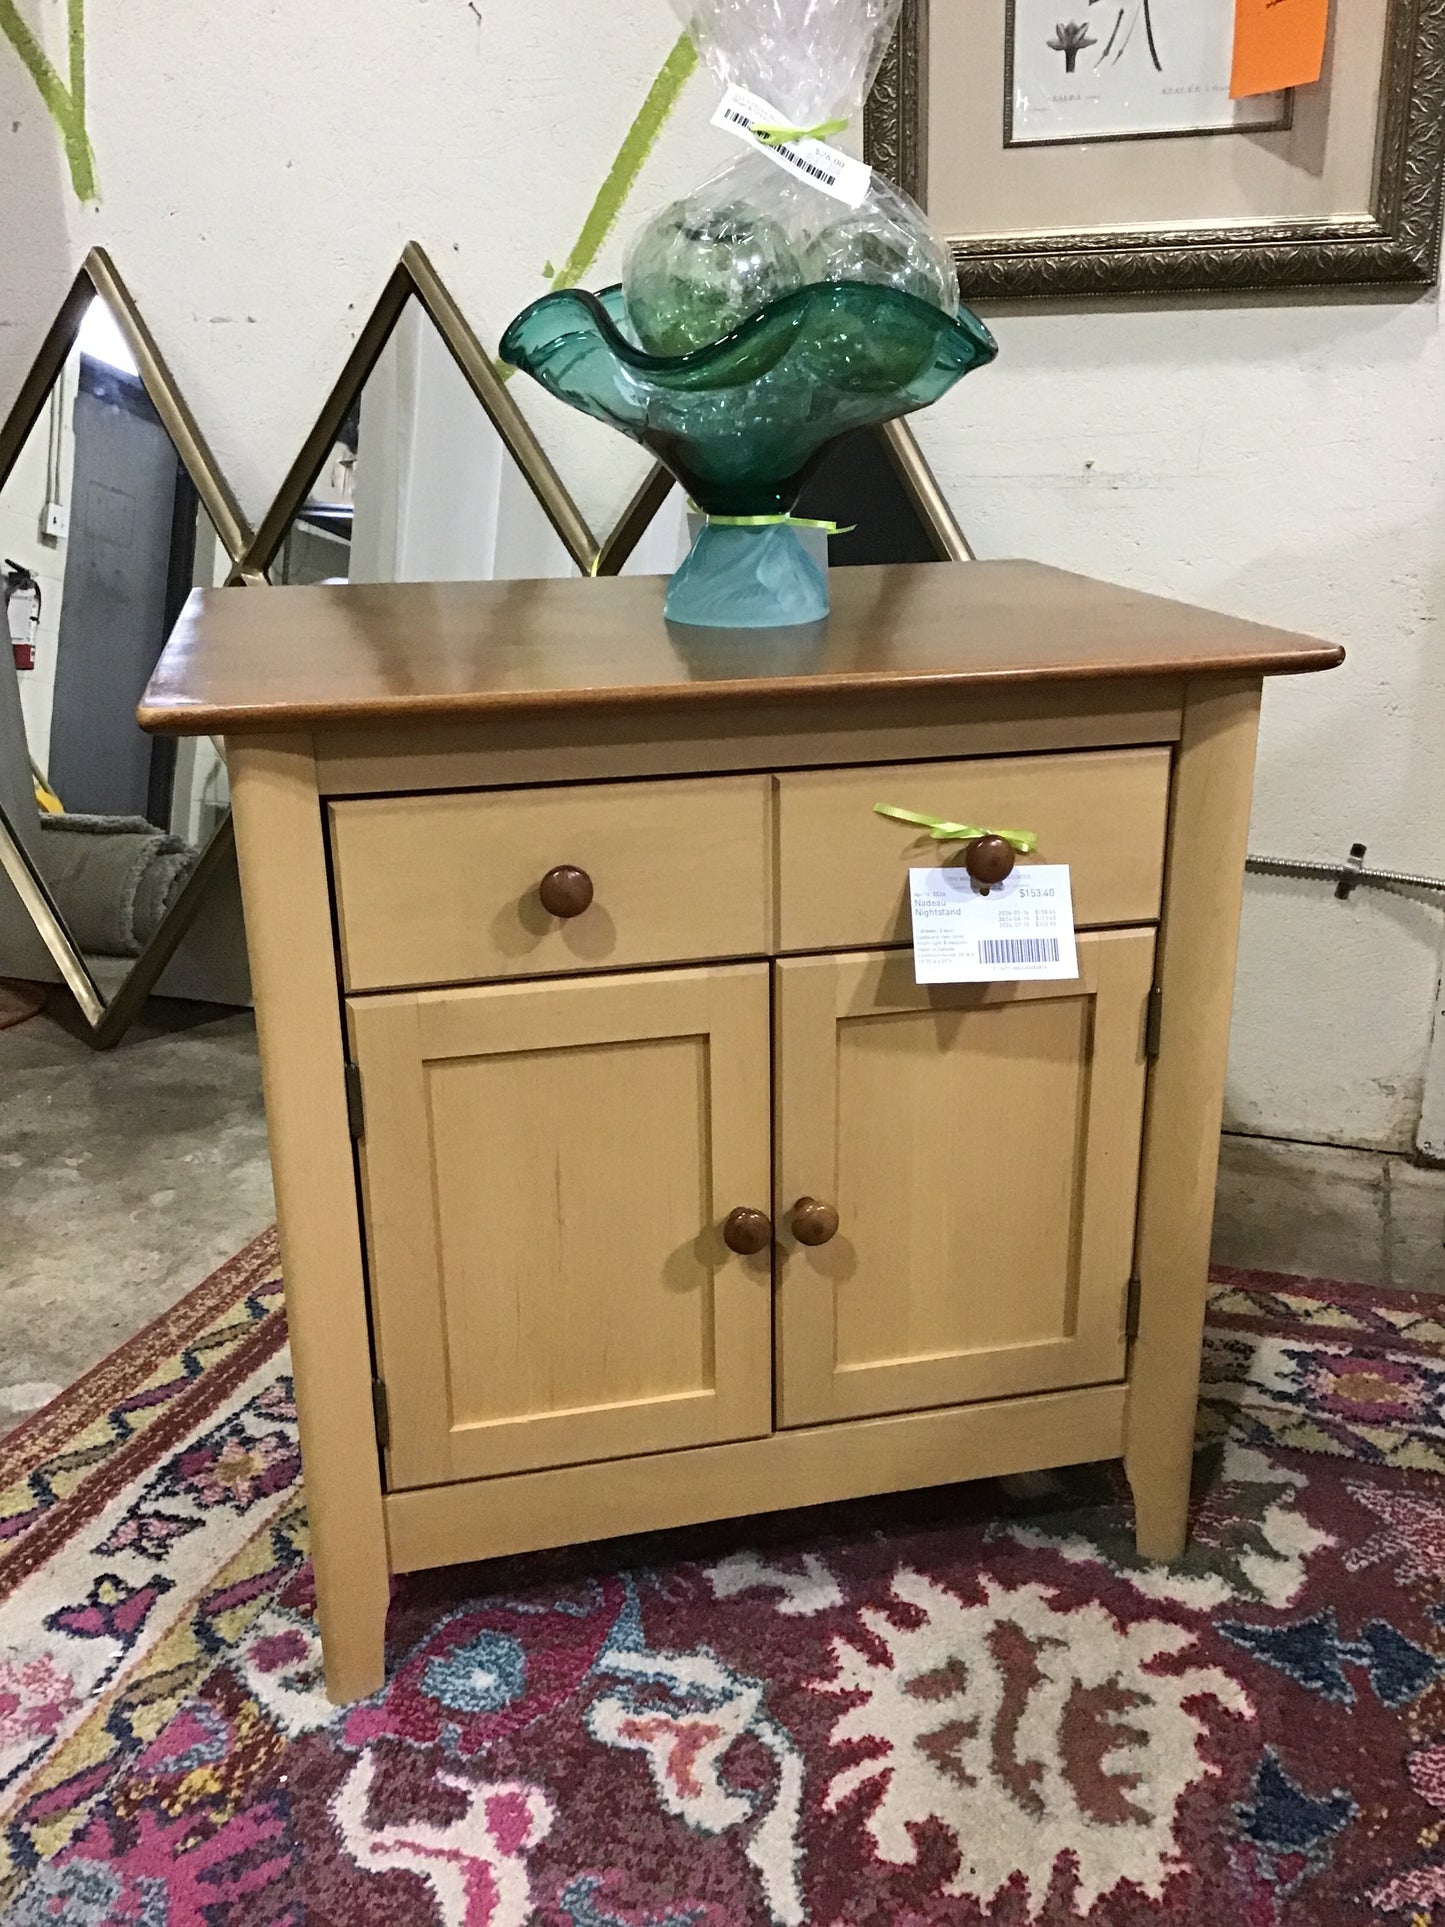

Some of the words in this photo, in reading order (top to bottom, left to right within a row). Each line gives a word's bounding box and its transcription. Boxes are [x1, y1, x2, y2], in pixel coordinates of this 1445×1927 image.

[1019, 888, 1055, 898] $153.40
[915, 899, 946, 907] Nadeau
[915, 908, 961, 918] Nightstand
